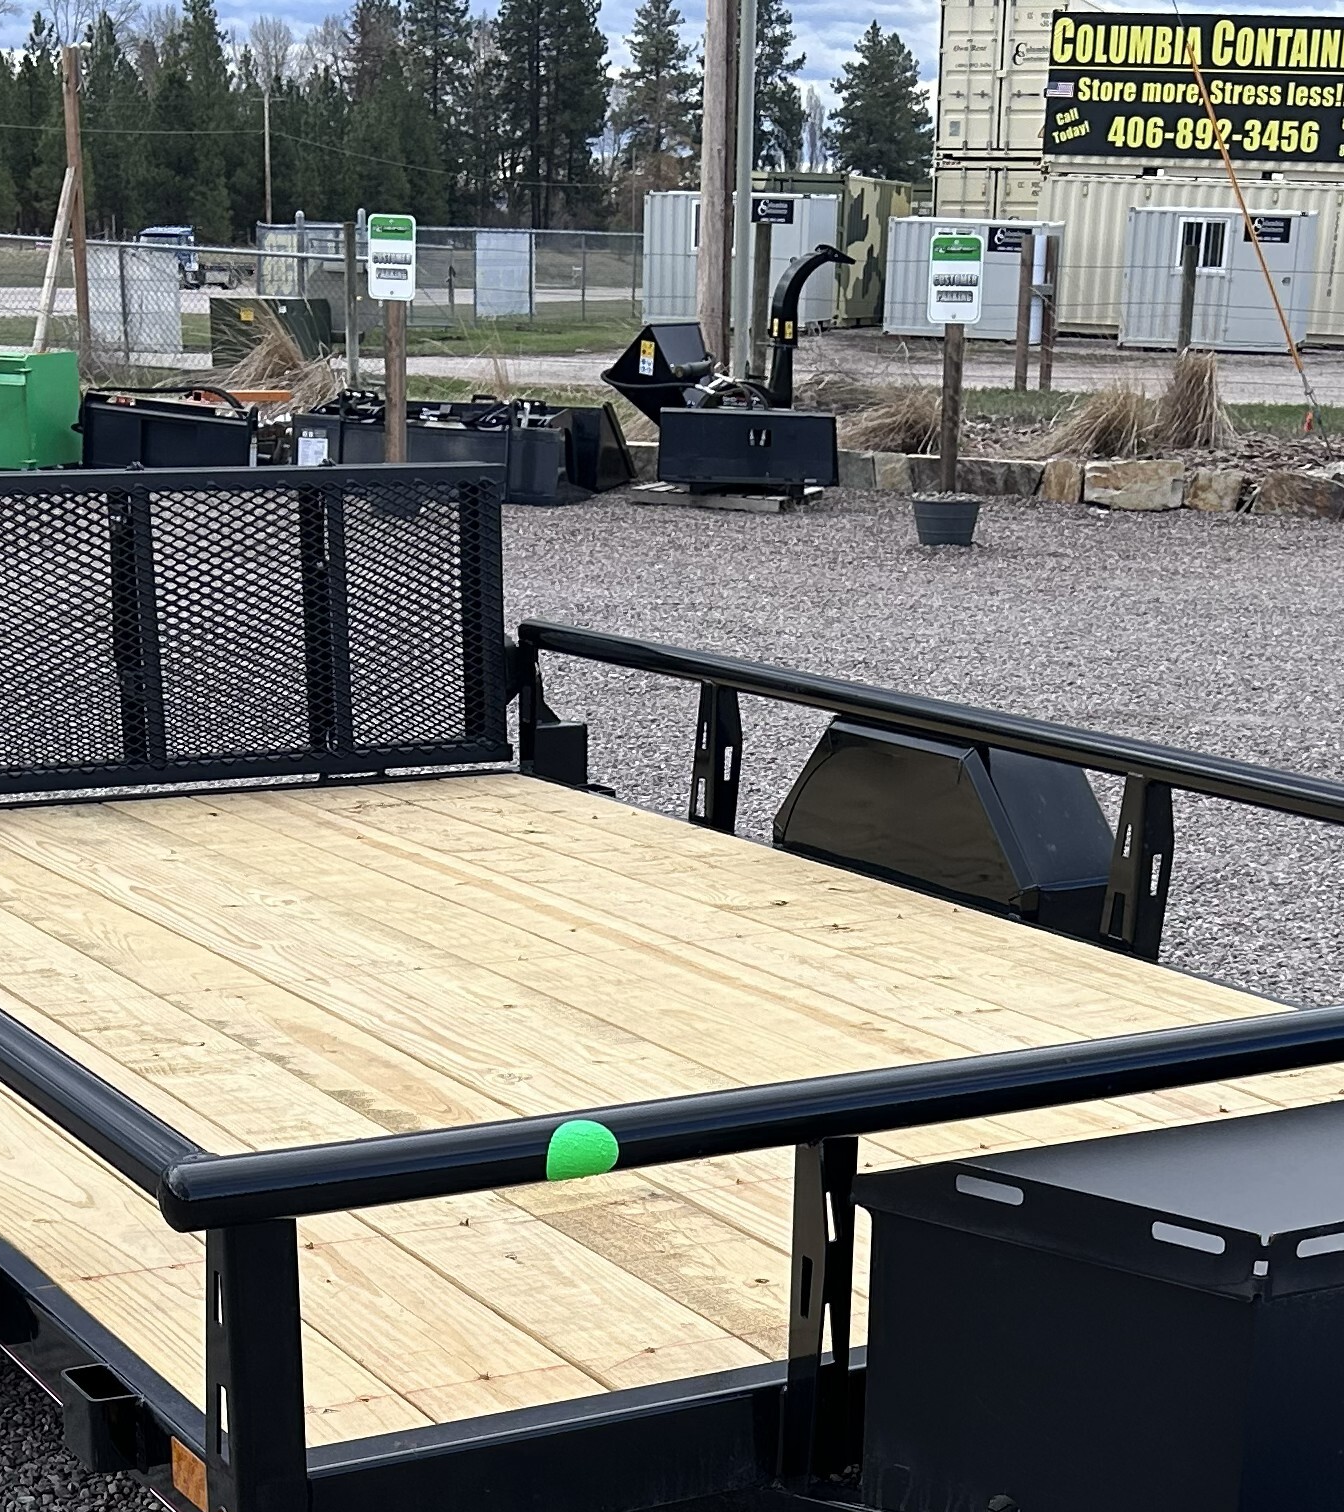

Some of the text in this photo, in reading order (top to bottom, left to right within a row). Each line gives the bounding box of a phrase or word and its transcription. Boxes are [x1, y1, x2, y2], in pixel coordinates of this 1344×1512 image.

[1052, 17, 1202, 65] COLUMBIA
[1077, 77, 1137, 102] Store
[1142, 81, 1205, 106] more,
[1210, 80, 1282, 106] Stress
[1056, 107, 1080, 126] Call
[1052, 120, 1091, 144] Today!
[1107, 115, 1320, 153] 406-892-3456
